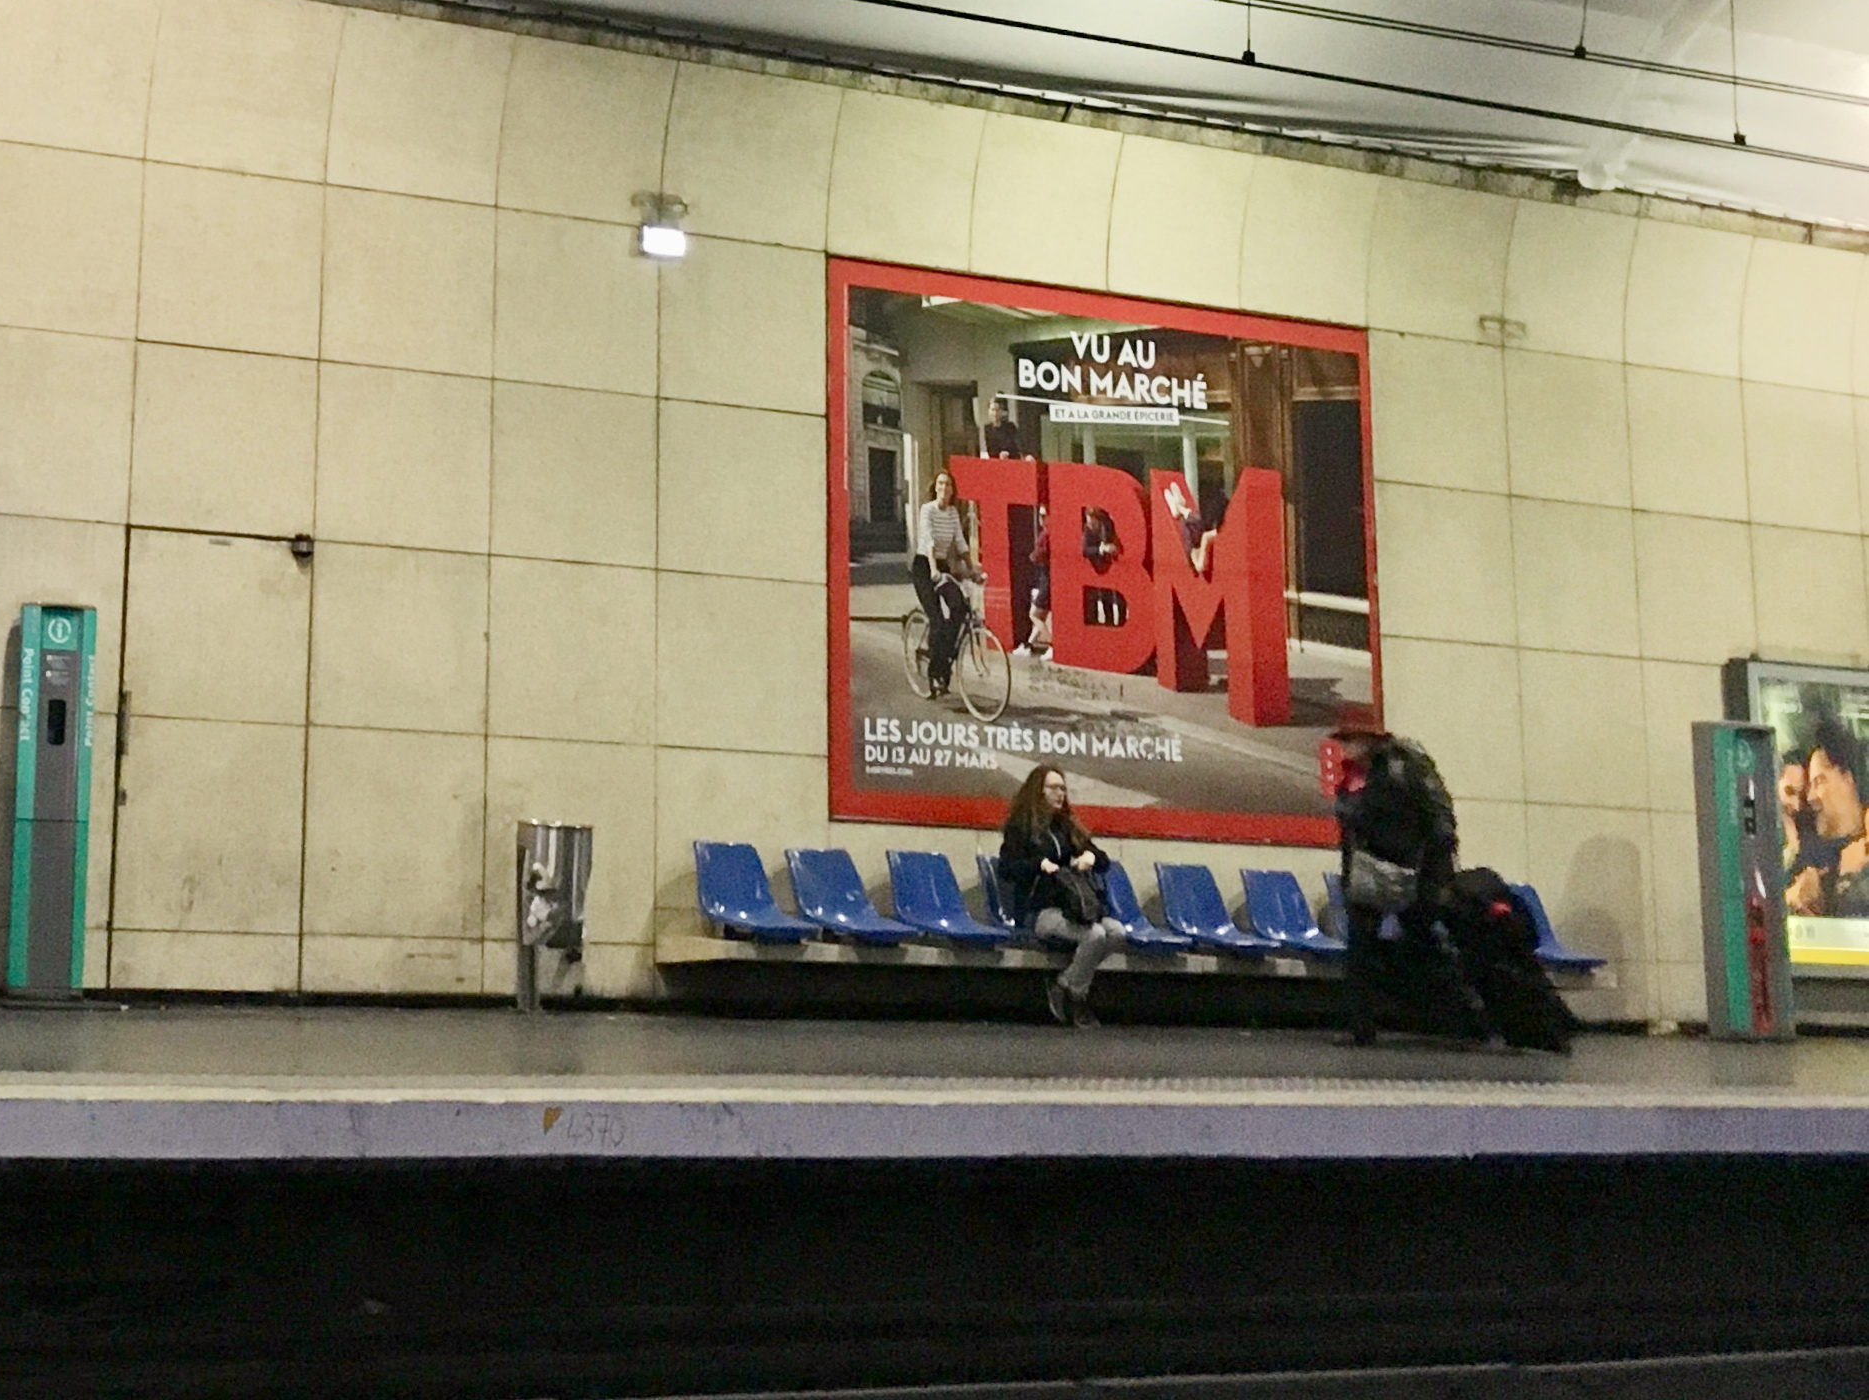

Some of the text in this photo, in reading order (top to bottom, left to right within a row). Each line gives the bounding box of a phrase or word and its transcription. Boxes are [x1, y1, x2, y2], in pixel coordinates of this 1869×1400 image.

[1070, 331, 1156, 370] VU AU
[1018, 358, 1208, 410] BON MARCHÉ
[1055, 409, 1066, 419] ET
[1077, 410, 1089, 419] LA
[1092, 410, 1132, 421] GRANDE
[1135, 409, 1175, 422] ÉPICERIE
[949, 455, 1293, 728] TBM
[21, 648, 35, 683] Point
[864, 717, 1183, 762] LES JOURS TRÈS BON MARCHÉ
[865, 745, 998, 770] DU 13 AU 27 MARS
